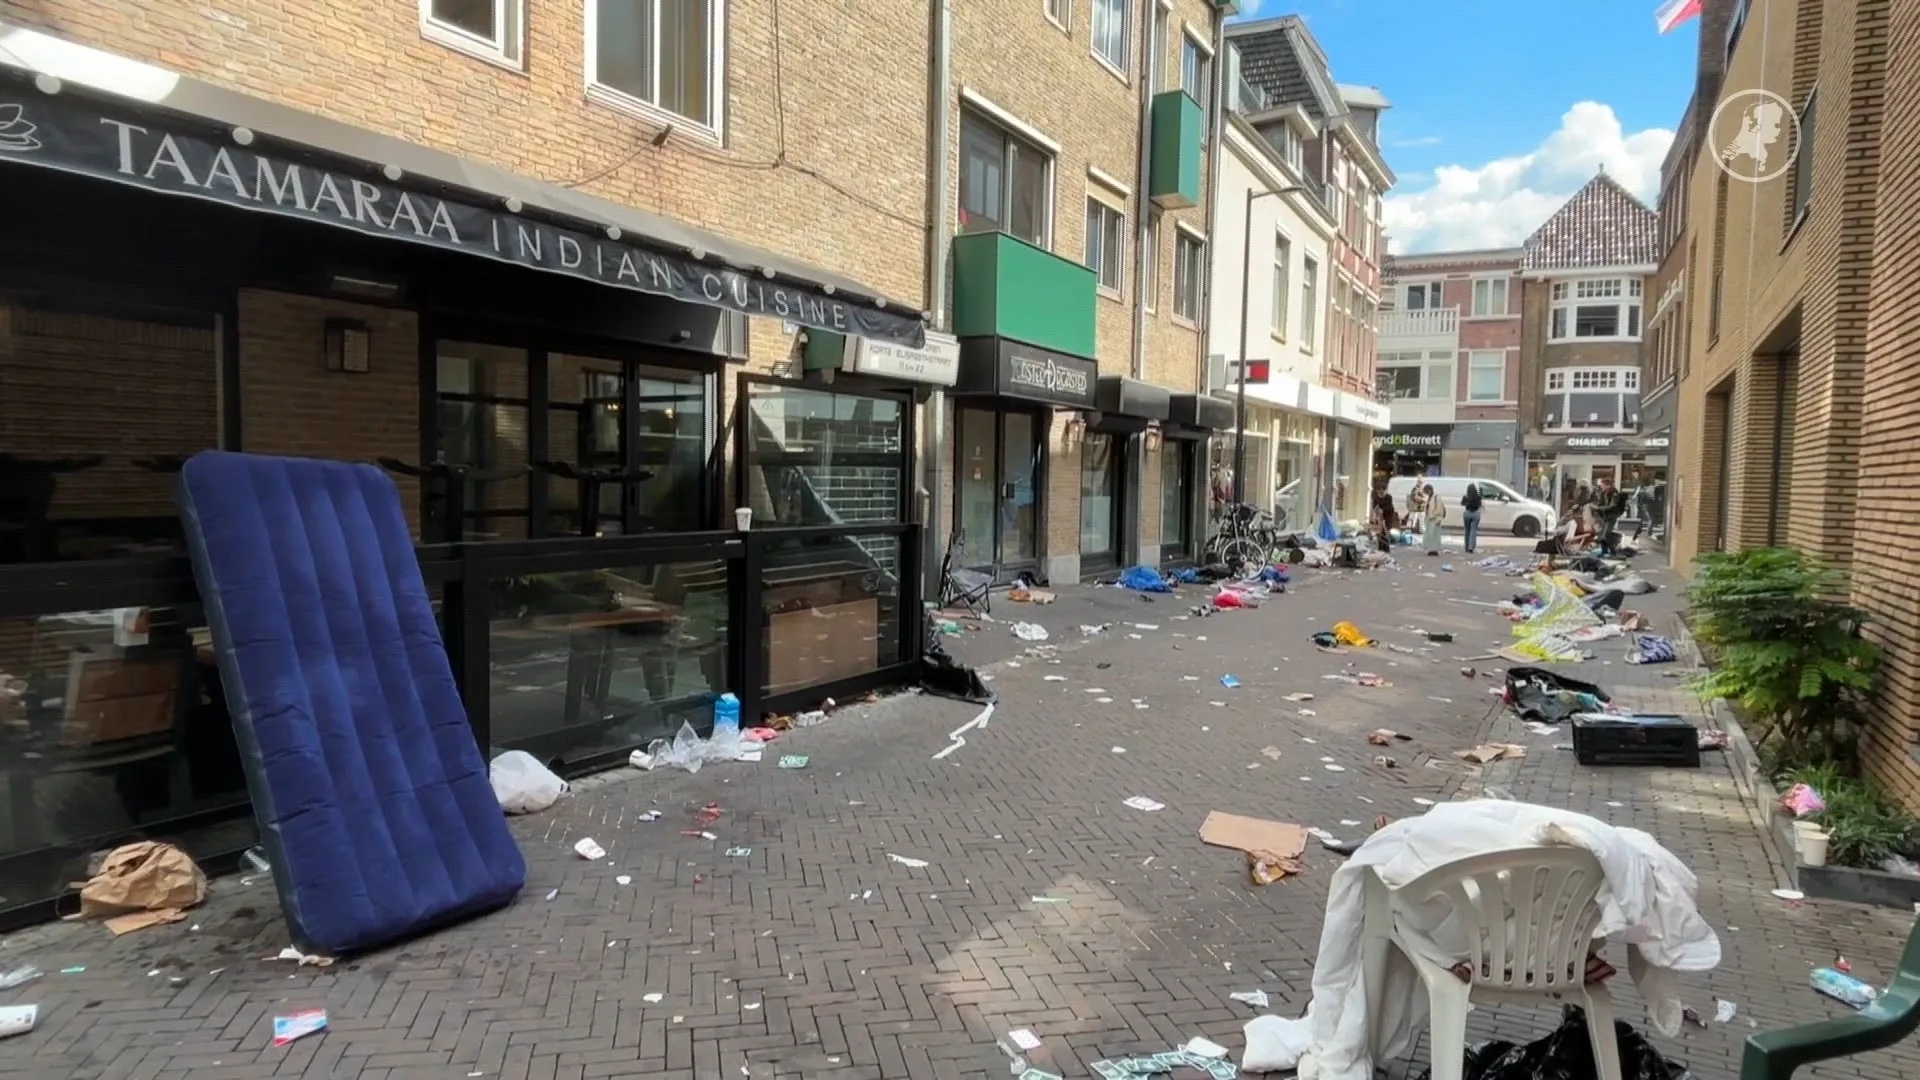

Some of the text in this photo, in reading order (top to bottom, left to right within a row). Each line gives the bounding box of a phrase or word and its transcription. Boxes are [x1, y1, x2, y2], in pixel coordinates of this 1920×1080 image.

[100, 118, 847, 329] TAAMARAA INDIAN CUISINE
[1402, 434, 1441, 446] Barrett
